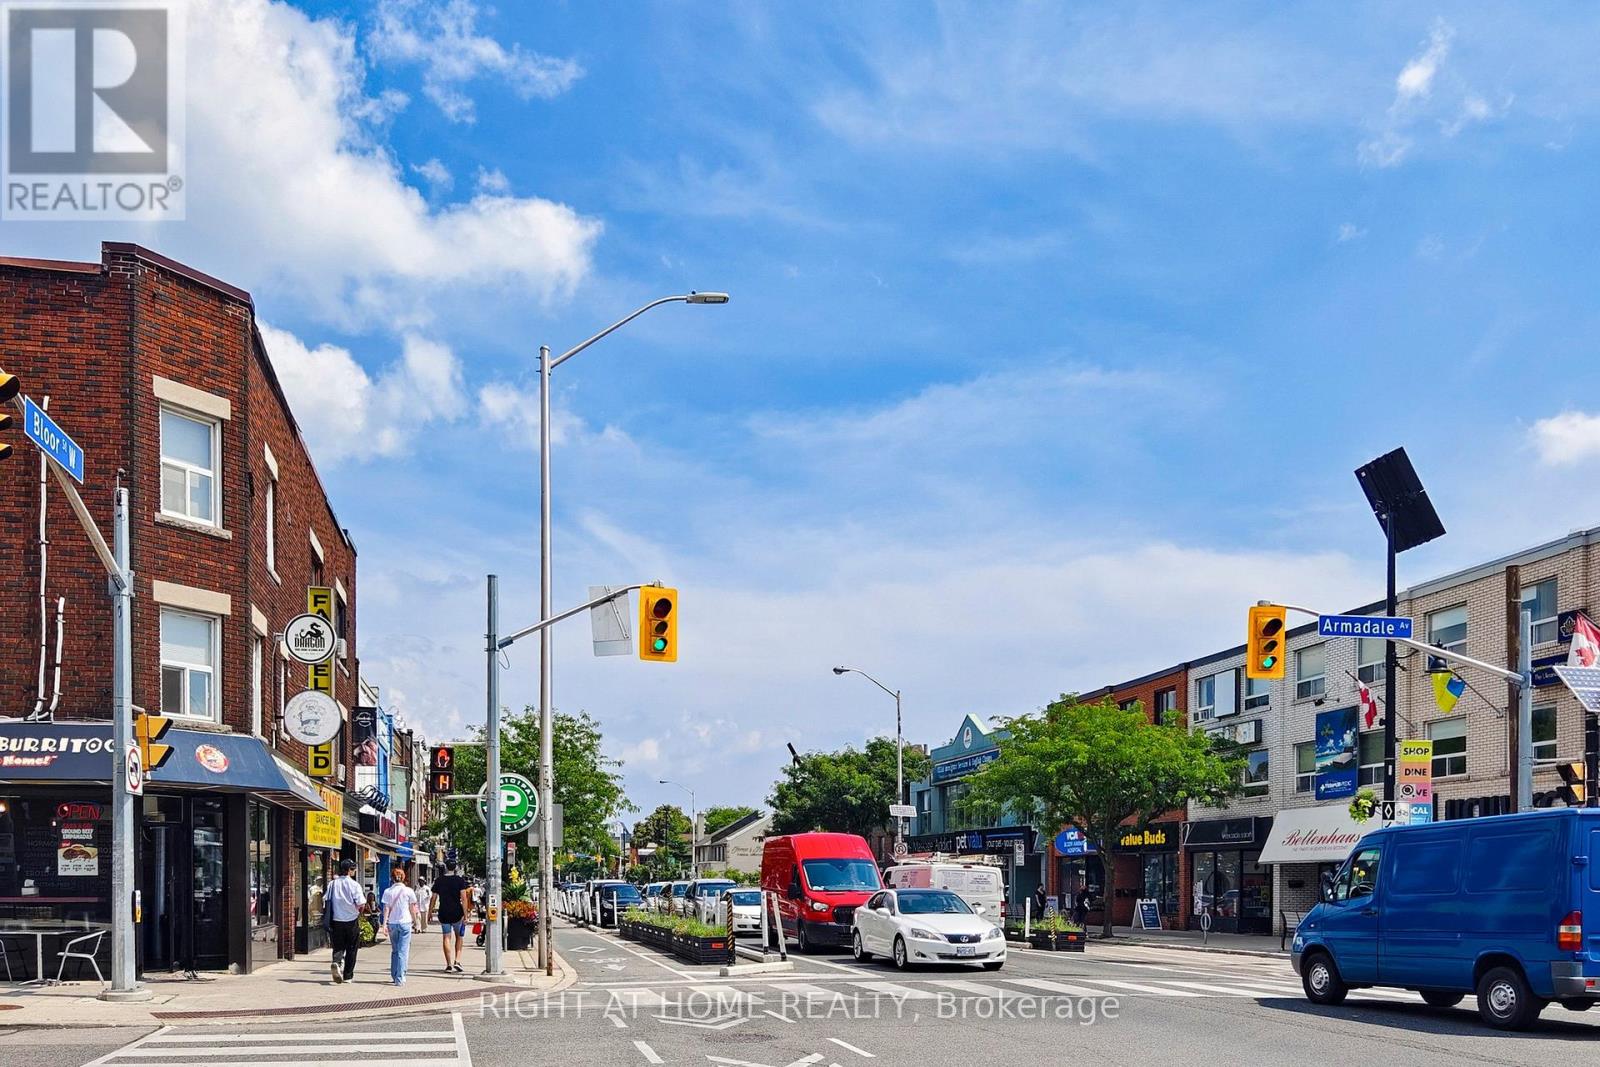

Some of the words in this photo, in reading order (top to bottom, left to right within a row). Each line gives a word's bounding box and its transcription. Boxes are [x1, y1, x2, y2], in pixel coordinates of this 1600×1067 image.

[33, 411, 60, 454] Bloor
[68, 445, 76, 469] W
[1322, 618, 1395, 635] Armadale
[1400, 621, 1409, 630] Av
[1403, 747, 1430, 756] SHOP
[1404, 768, 1428, 776] DINE
[500, 789, 522, 812] P
[57, 804, 99, 819] OPEN
[955, 833, 967, 852] pet
[1143, 829, 1166, 845] Buds
